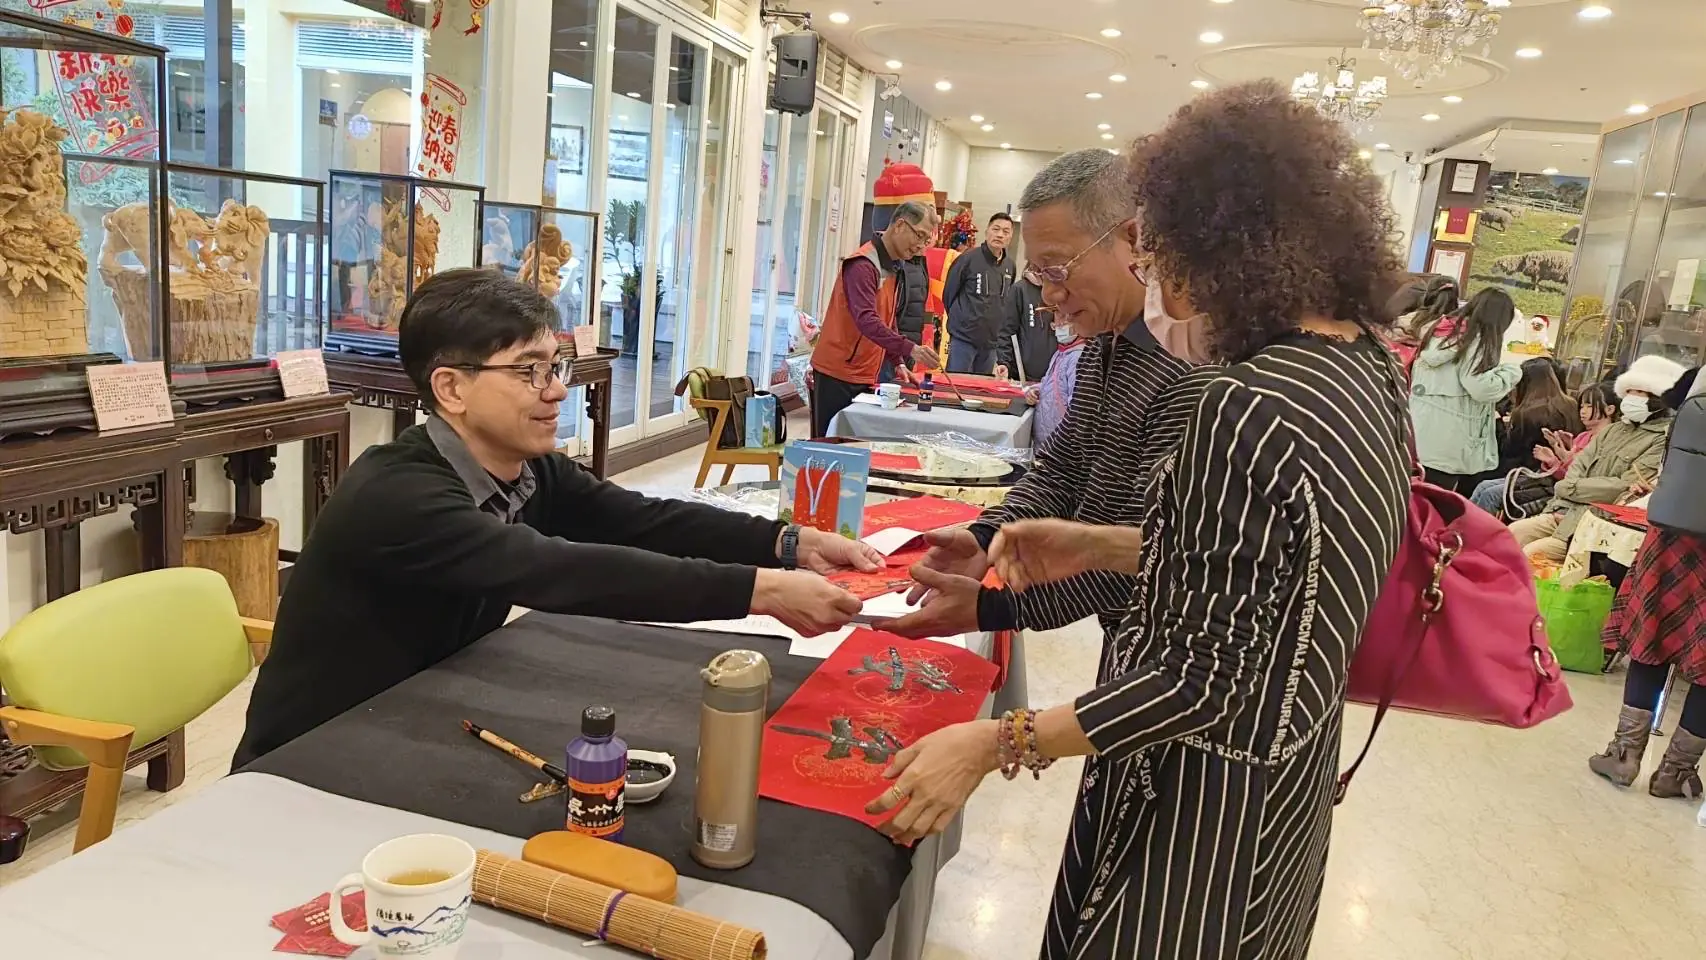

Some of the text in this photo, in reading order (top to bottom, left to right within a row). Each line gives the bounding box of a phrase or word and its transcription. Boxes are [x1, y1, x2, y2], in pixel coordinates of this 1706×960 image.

[71, 71, 132, 120] 快樂
[423, 132, 455, 174] 納福
[428, 107, 457, 145] 迎春
[1142, 517, 1166, 584] PERCIVAL&
[1308, 500, 1321, 559] MERLIN&
[1304, 558, 1320, 599] ELOT&
[1291, 598, 1317, 667] PERCIVAL&
[1277, 668, 1301, 727] ARTHUR&
